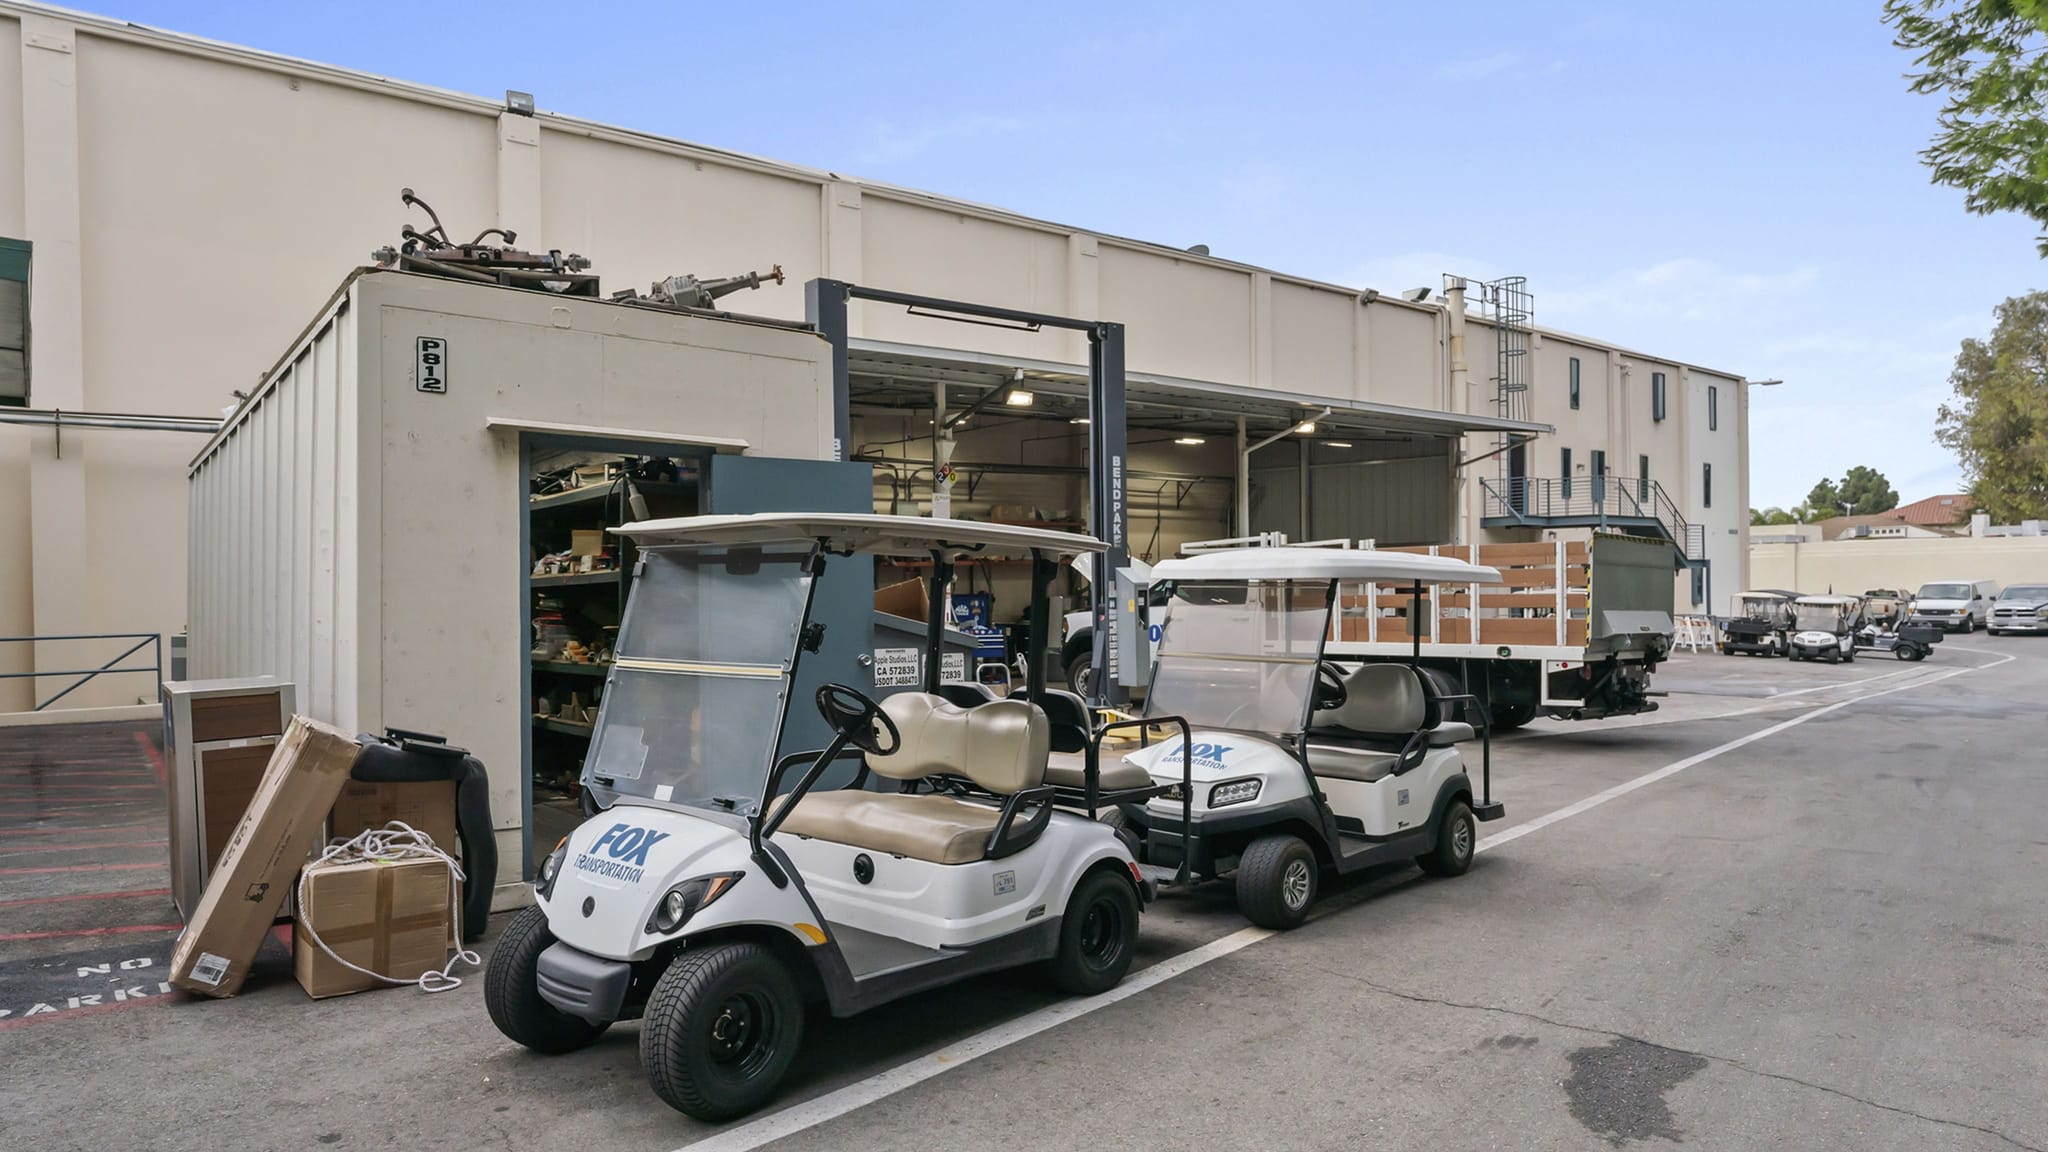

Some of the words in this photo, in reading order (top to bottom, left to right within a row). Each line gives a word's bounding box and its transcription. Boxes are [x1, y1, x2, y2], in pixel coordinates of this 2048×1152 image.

[422, 340, 441, 389] P812
[938, 471, 944, 481] 2
[1112, 455, 1121, 534] BENDPAK
[877, 667, 888, 676] CA
[889, 666, 915, 676] 572839
[942, 670, 962, 679] 72839
[589, 823, 671, 866] FOX
[573, 853, 645, 884] TRANSPORTATION
[77, 957, 153, 978] NO
[0, 981, 172, 1018] ARKI
